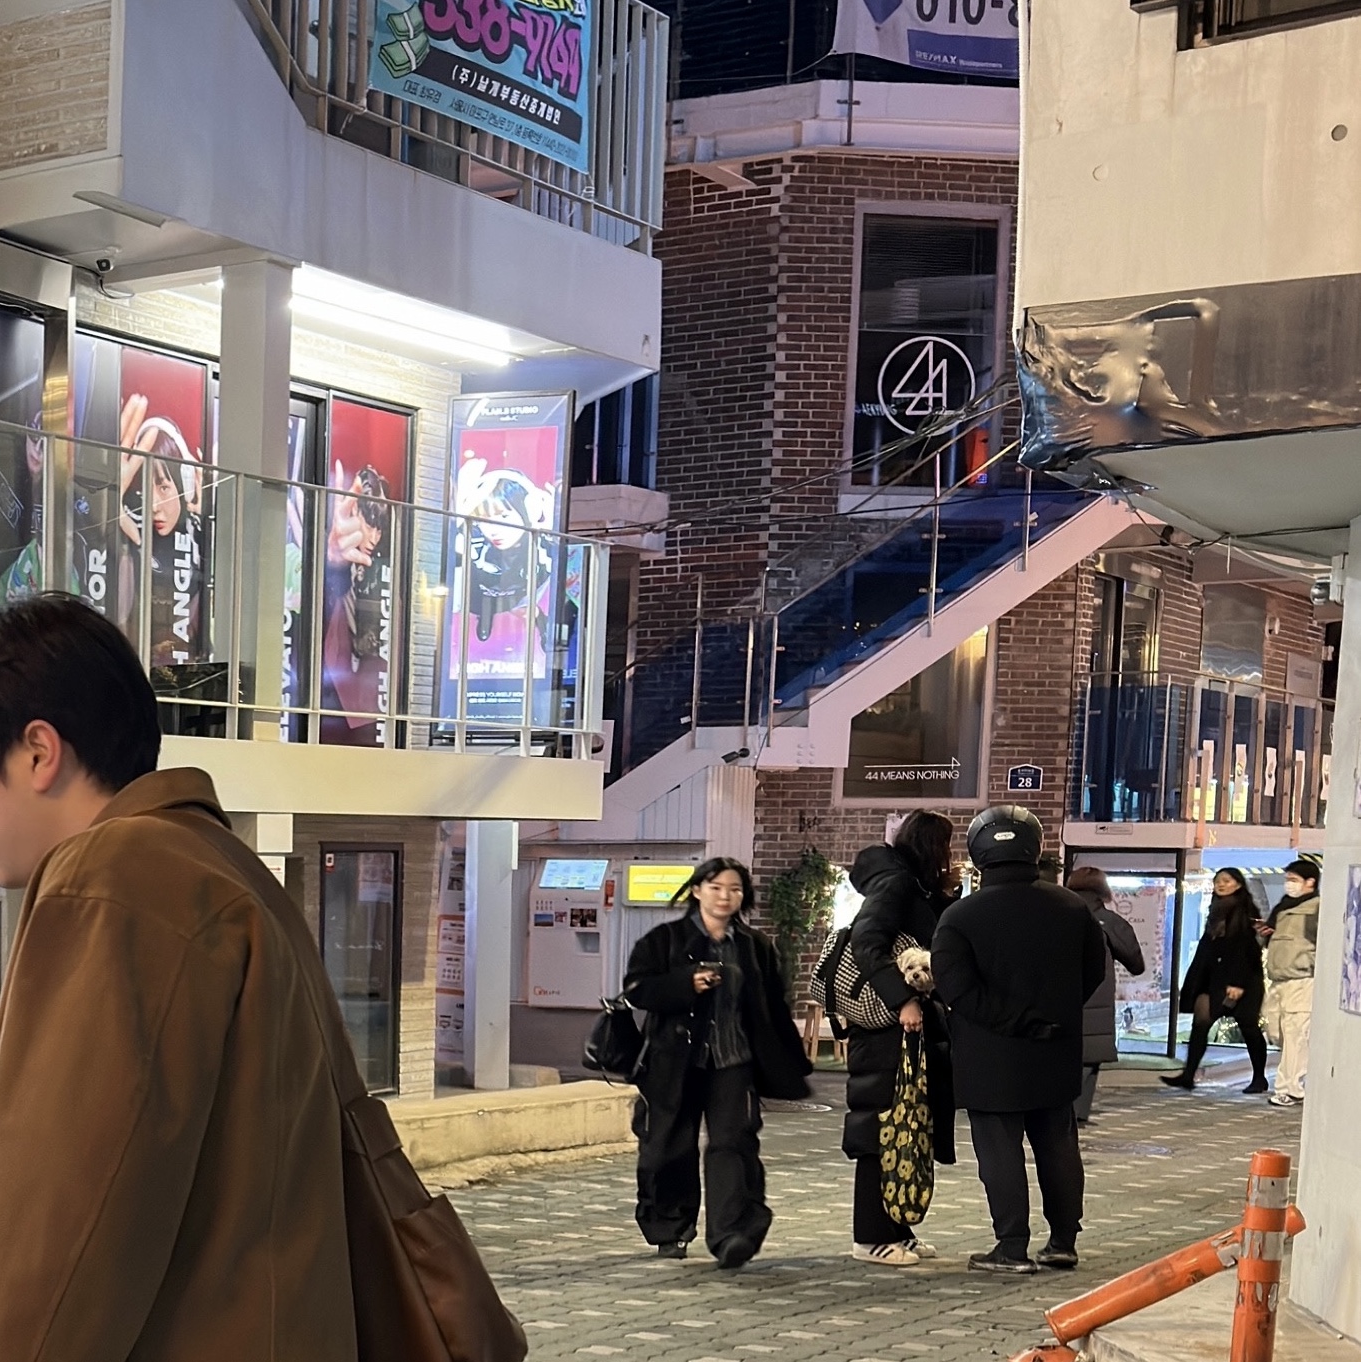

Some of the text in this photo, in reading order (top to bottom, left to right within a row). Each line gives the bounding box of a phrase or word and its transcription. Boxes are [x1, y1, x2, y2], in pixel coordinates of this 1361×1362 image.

[173, 531, 192, 643] ANGLE
[880, 771, 916, 781] MEANS
[917, 769, 960, 781] NOTHING
[1018, 777, 1033, 788] 28
